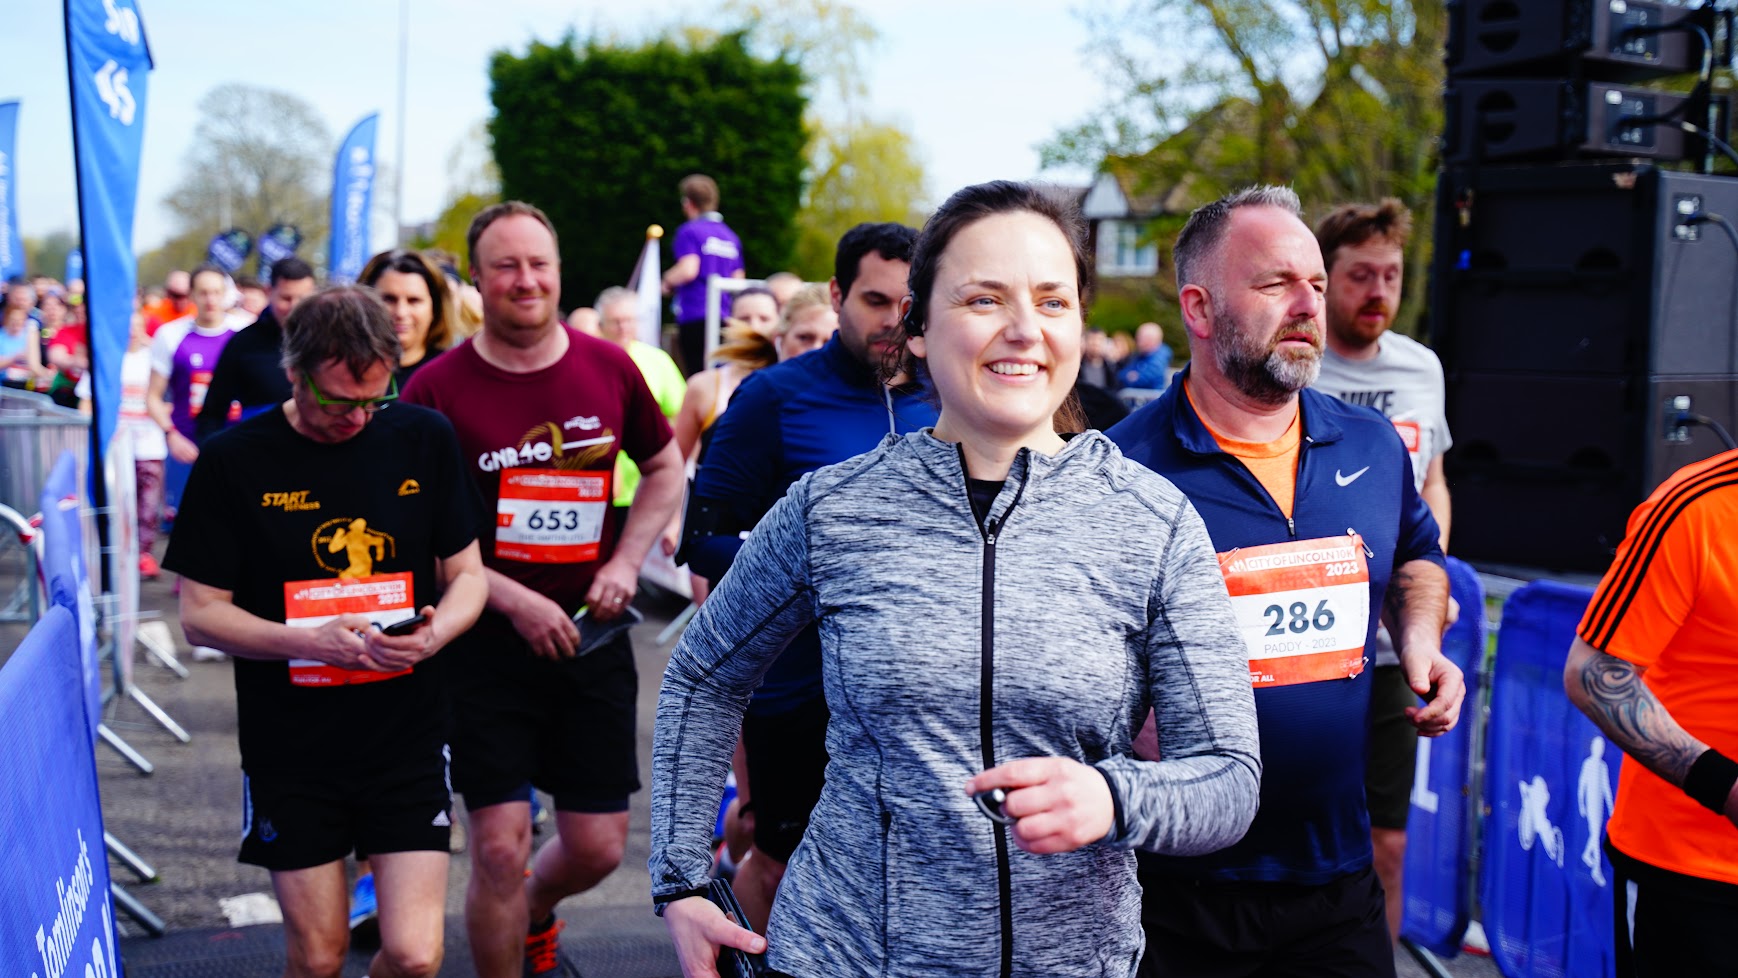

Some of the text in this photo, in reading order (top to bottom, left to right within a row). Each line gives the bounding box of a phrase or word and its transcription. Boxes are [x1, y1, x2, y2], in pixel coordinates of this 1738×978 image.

[478, 441, 553, 472] GNR40
[261, 490, 311, 507] START
[528, 508, 579, 531] 653
[1248, 547, 1354, 570] CITY OF LINCOLN 10K
[1326, 561, 1359, 577] 2023
[1263, 600, 1336, 637] 286
[1264, 641, 1303, 654] PADDY
[1312, 637, 1337, 649] 2023
[1261, 674, 1275, 682] ALL
